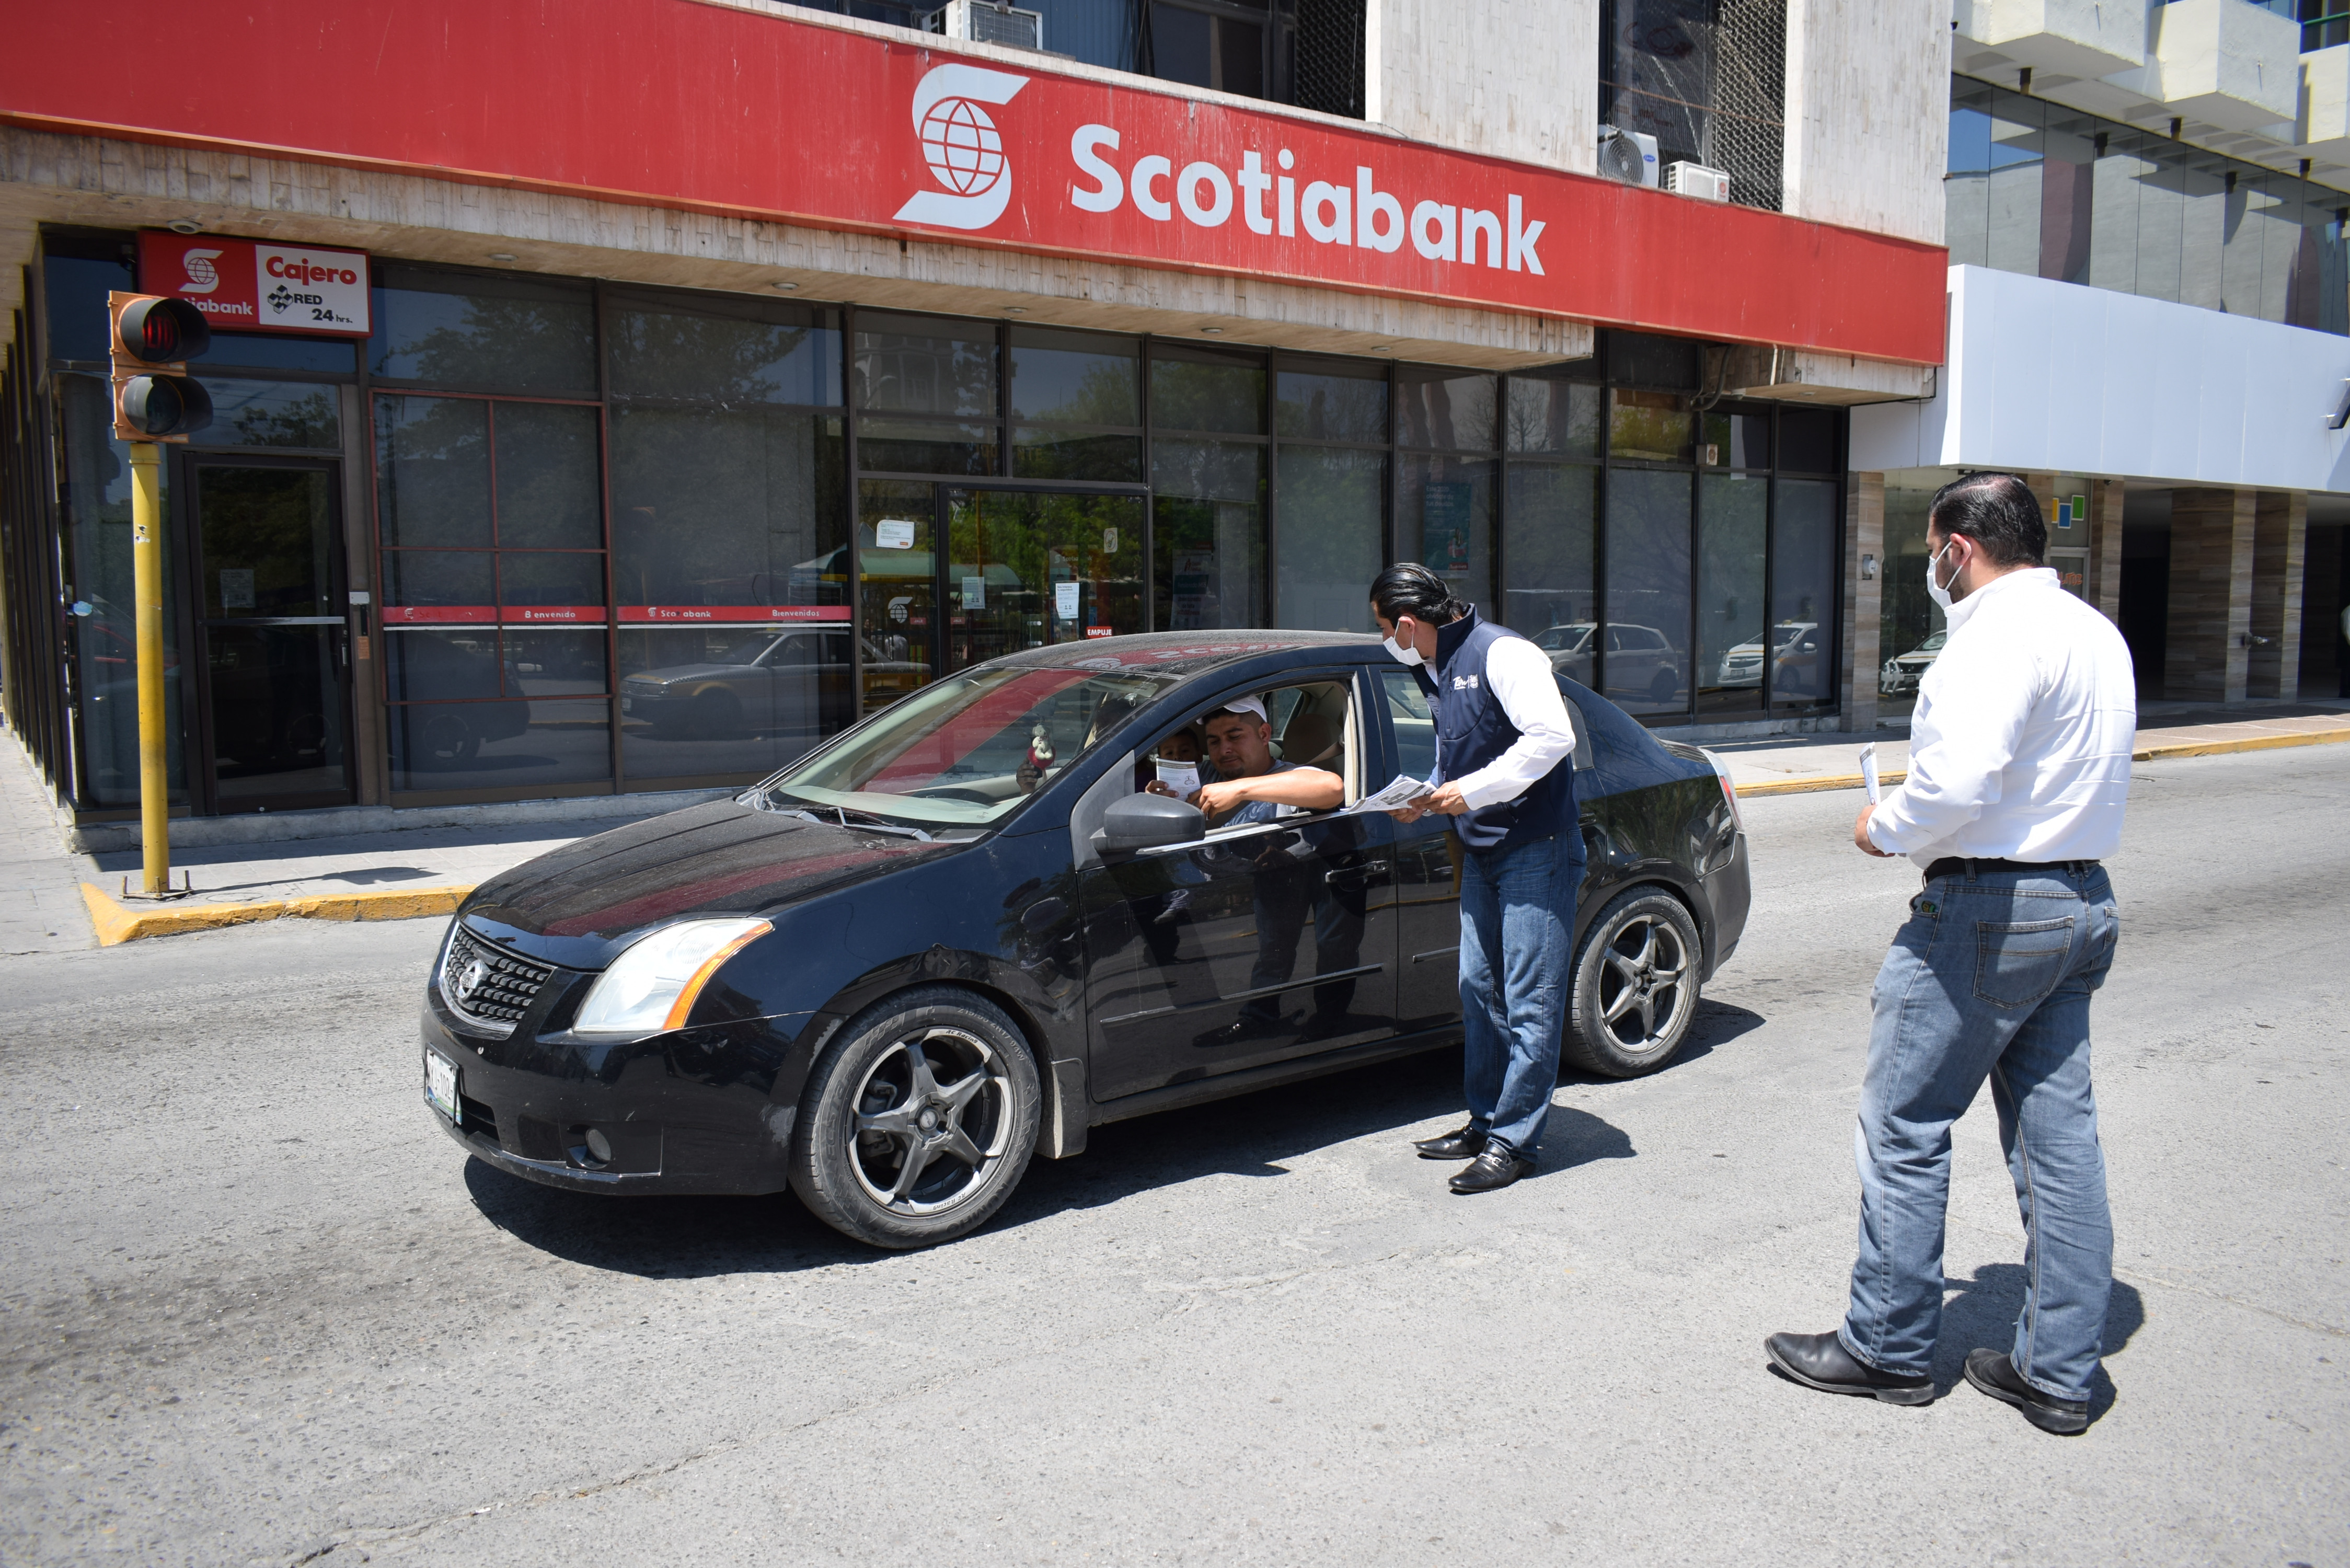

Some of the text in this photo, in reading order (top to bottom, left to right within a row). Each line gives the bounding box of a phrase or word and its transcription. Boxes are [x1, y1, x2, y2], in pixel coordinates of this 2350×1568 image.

[1070, 123, 1547, 276] Scotiabank
[266, 256, 357, 286] Cajero
[293, 295, 322, 305] RED
[312, 308, 353, 324] 24 hrs.
[142, 315, 174, 350] LTO
[1652, 897, 1670, 906] 215/55
[956, 1032, 978, 1044] Racing
[1010, 1040, 1026, 1061] 94W
[933, 1198, 955, 1210] Racing
[947, 1182, 1009, 1233] KUMHO
